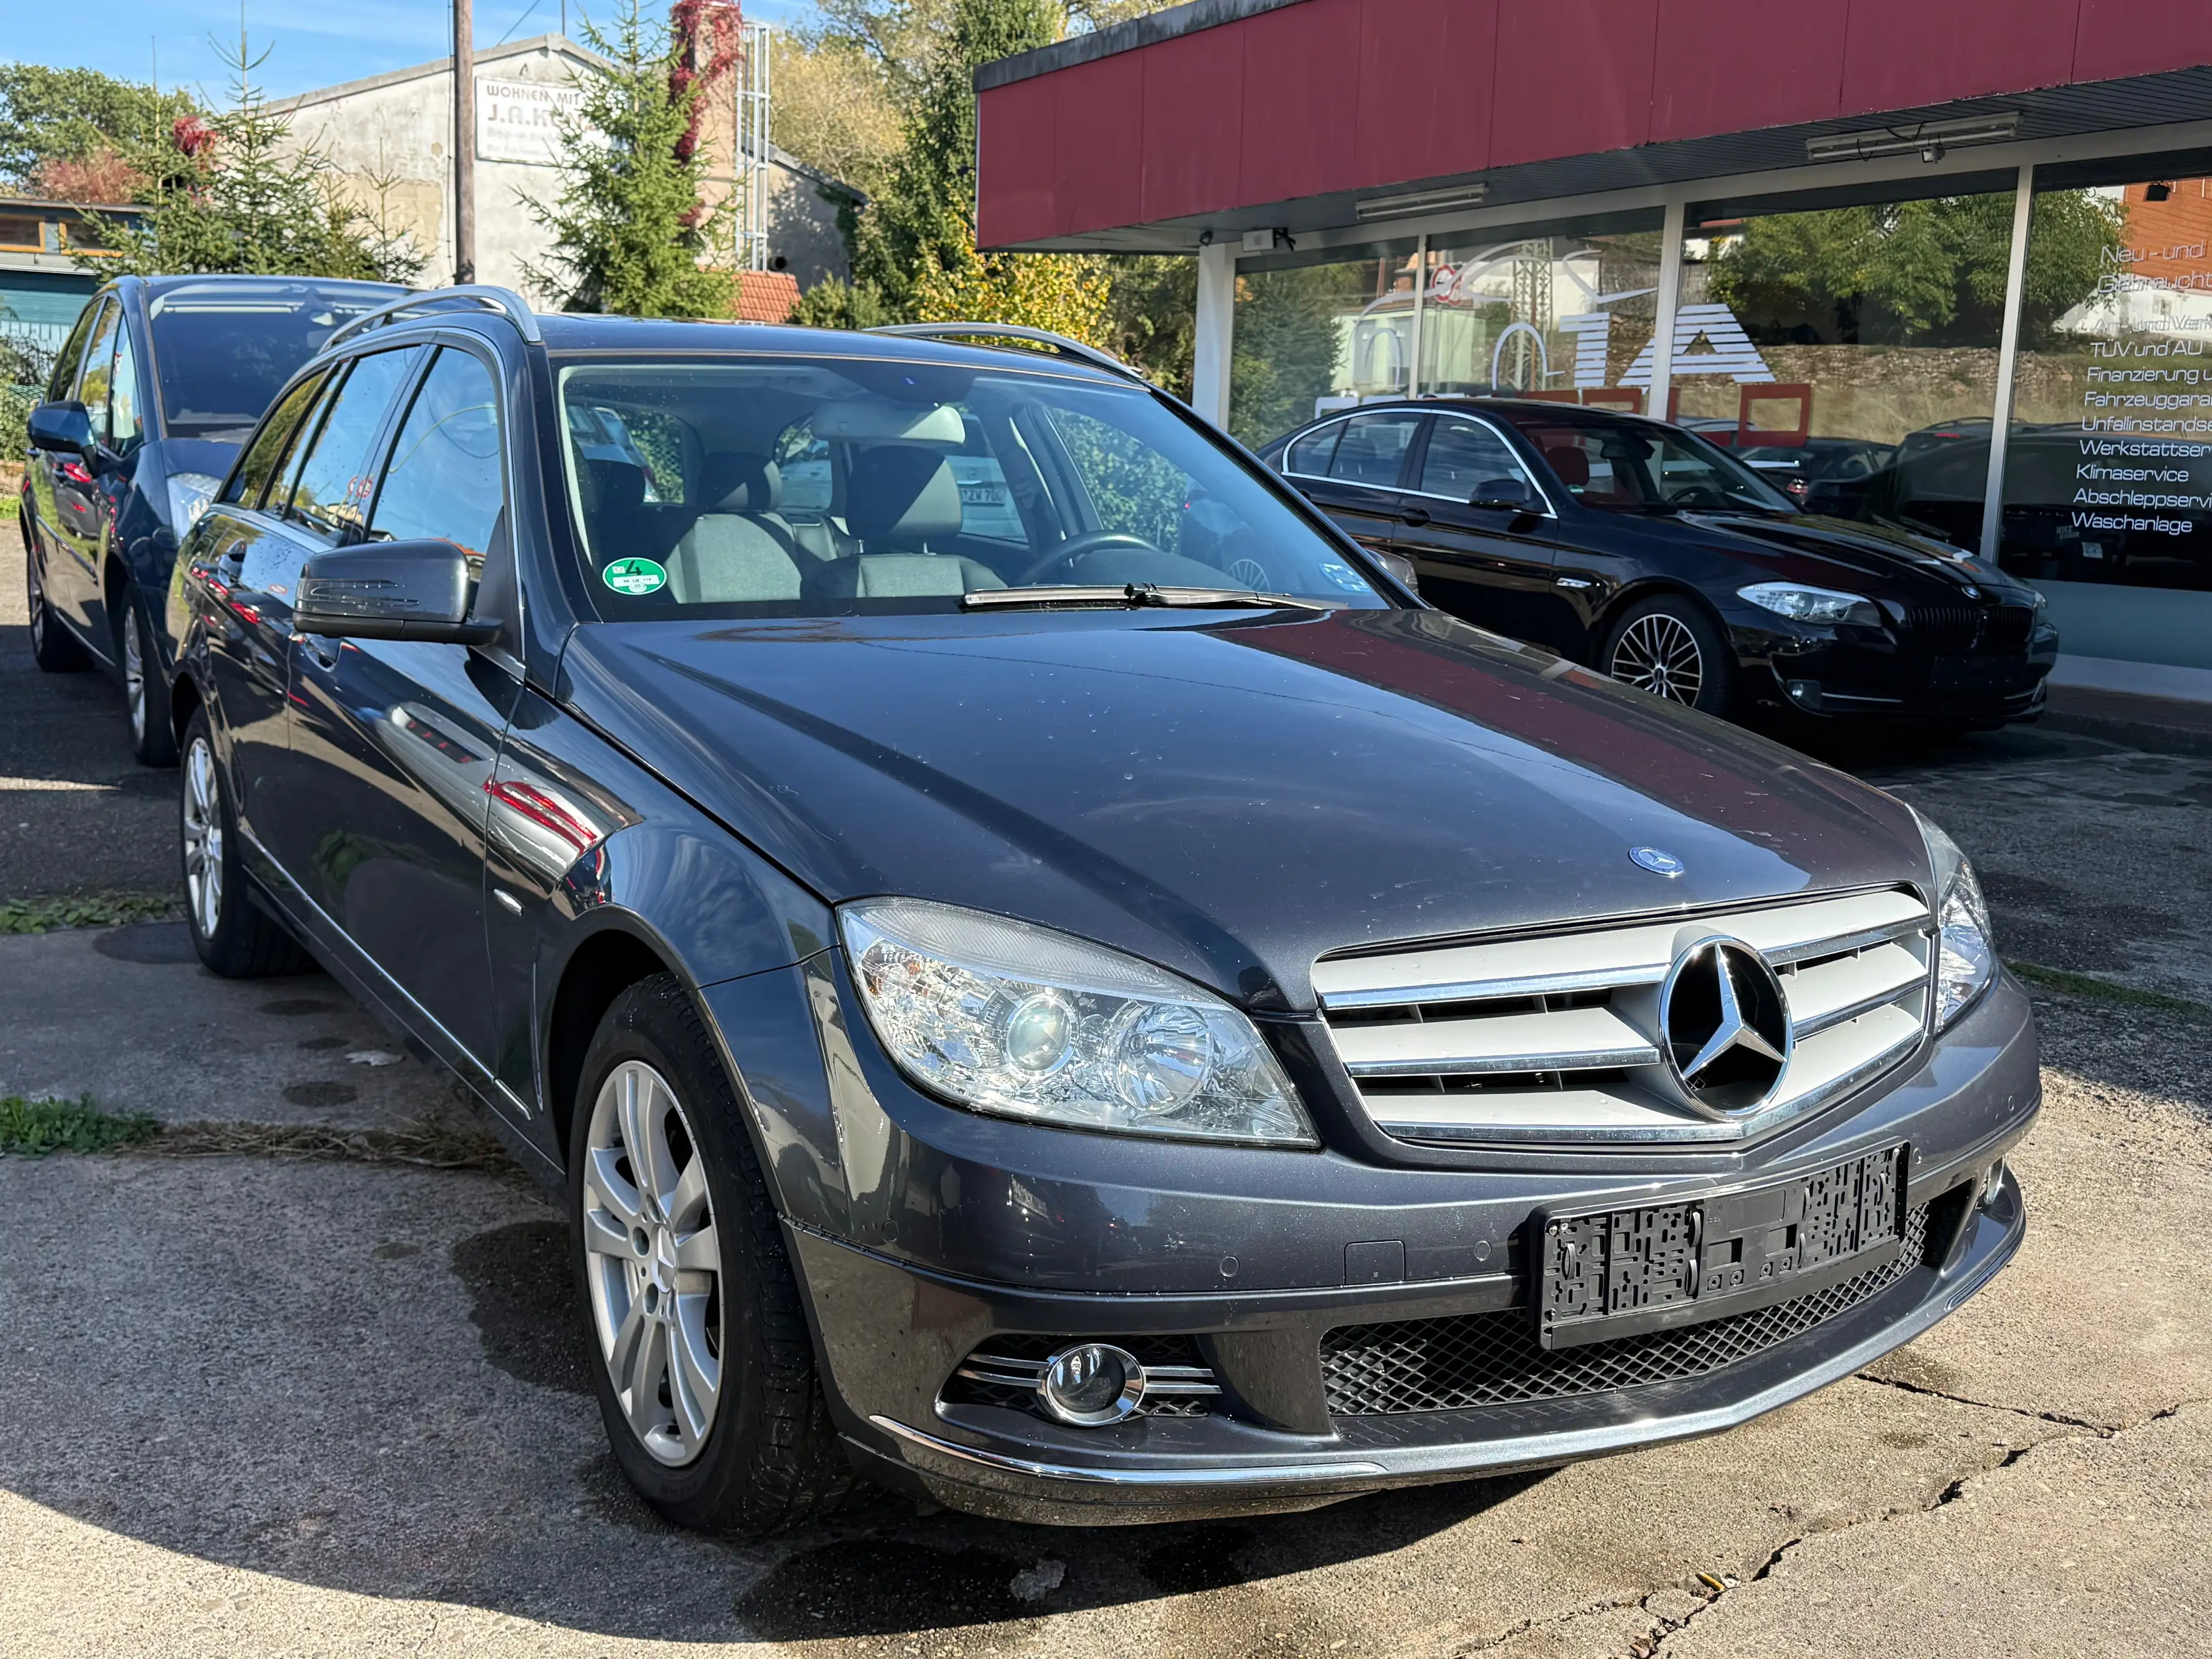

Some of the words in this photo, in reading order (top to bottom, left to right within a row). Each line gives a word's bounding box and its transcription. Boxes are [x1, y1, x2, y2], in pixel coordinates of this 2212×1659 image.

[486, 85, 548, 102] WOHNEN
[557, 92, 580, 105] MIT
[2163, 239, 2205, 260] und
[2090, 338, 2133, 358] TÜV
[2134, 341, 2169, 357] und
[2171, 339, 2203, 356] AU
[2086, 366, 2199, 384] Finanzierung
[2076, 463, 2189, 482] Klimaservice
[2071, 512, 2192, 536] Waschanlage
[626, 559, 643, 575] 4
